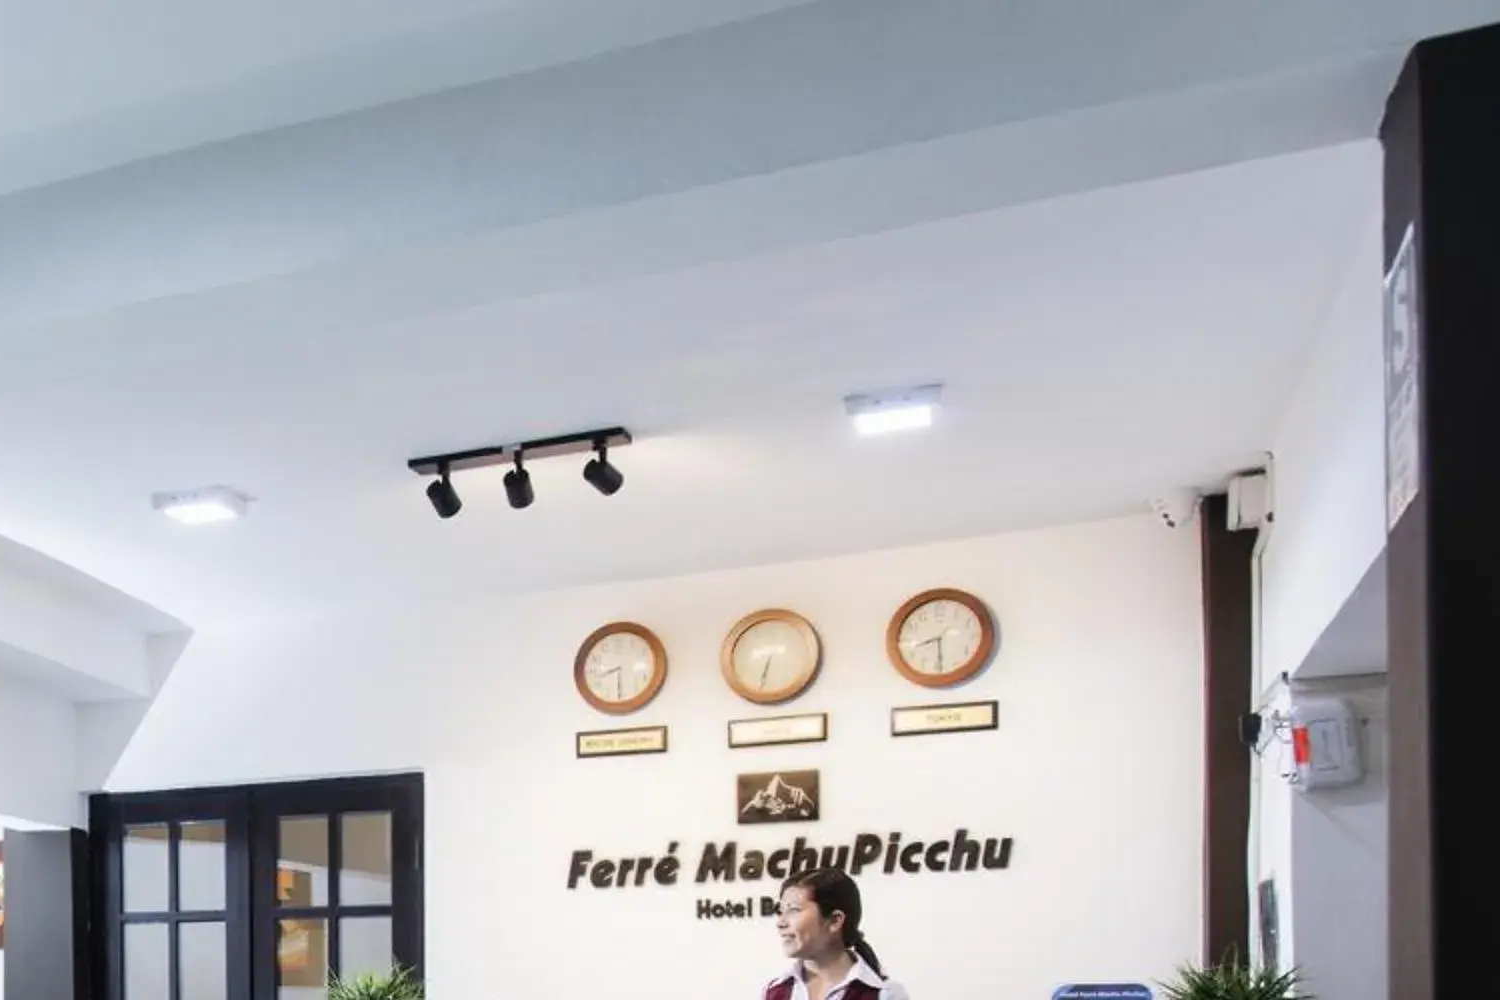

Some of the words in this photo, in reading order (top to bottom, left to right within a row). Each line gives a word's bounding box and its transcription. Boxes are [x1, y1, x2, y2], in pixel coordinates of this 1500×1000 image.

[567, 841, 681, 889] Ferré
[695, 829, 1014, 884] MachuPicchu
[696, 897, 753, 920] Hotel
